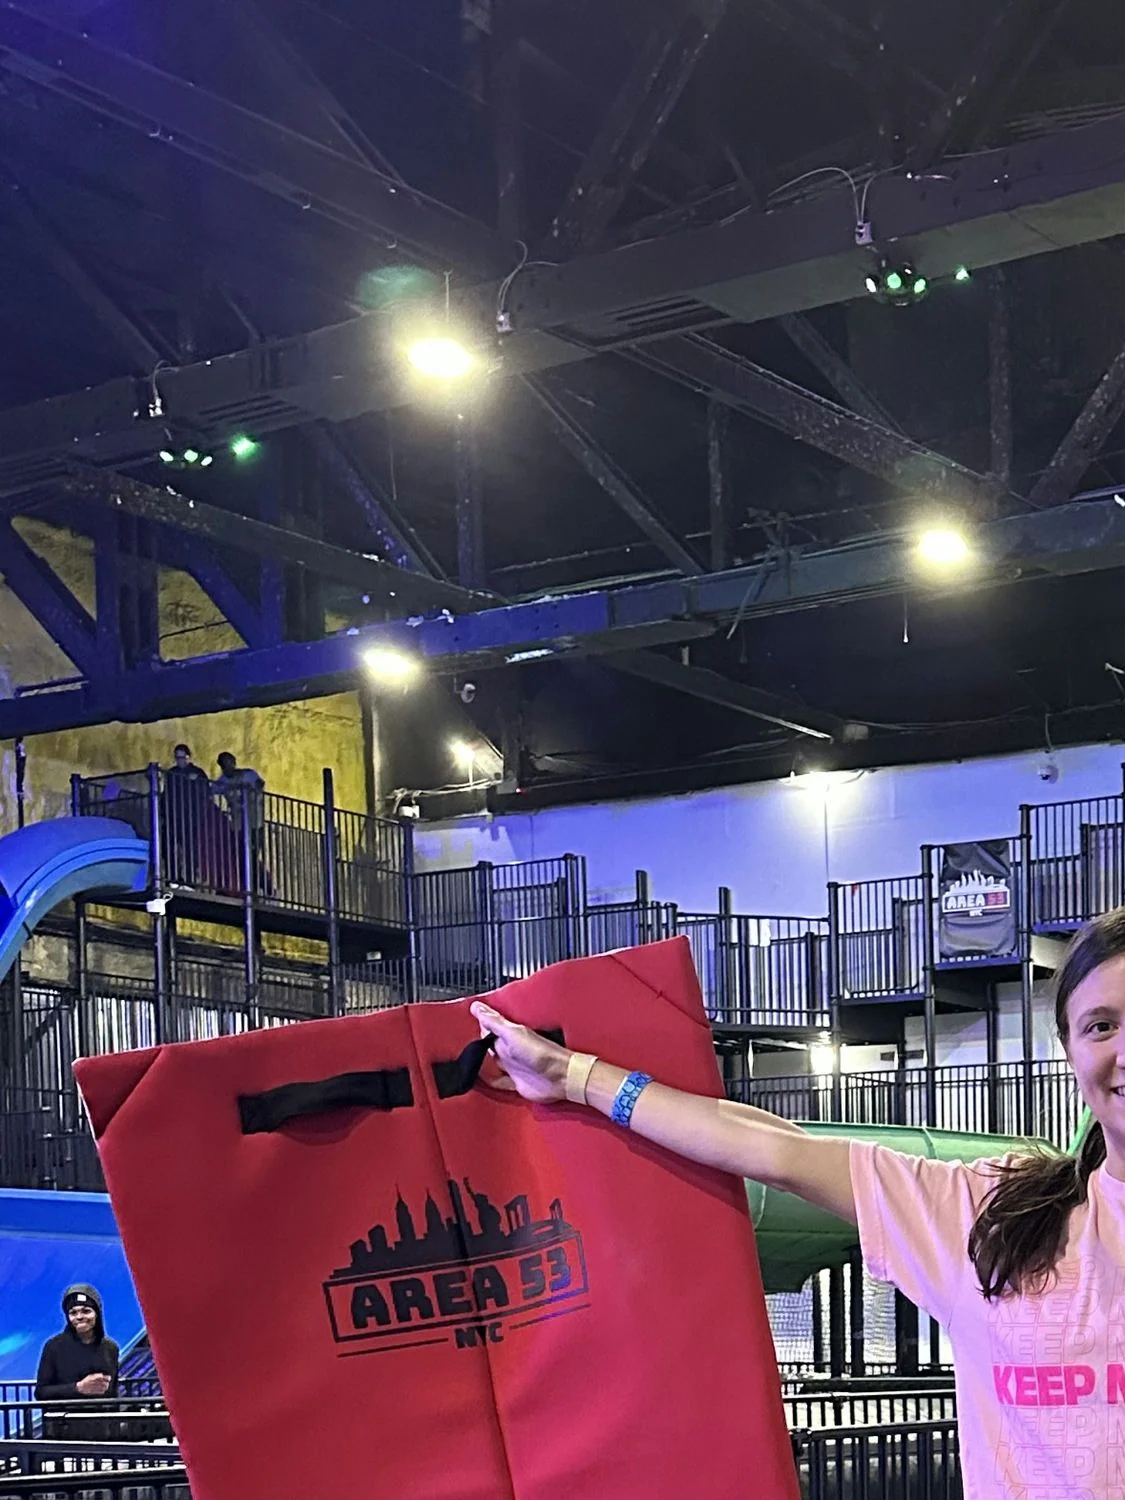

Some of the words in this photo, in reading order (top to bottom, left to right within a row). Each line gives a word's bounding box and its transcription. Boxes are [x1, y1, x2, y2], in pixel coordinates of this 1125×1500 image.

[946, 893, 986, 910] AREA
[987, 892, 1006, 906] 53
[350, 1264, 510, 1330] AREA
[519, 1246, 573, 1300] 53
[988, 1287, 1102, 1324] KEEP
[454, 1321, 505, 1350] NYC
[988, 1322, 1097, 1364] KEEP
[992, 1363, 1097, 1406] KEEP
[998, 1404, 1098, 1446] KEEP
[994, 1444, 1097, 1486] KEEP
